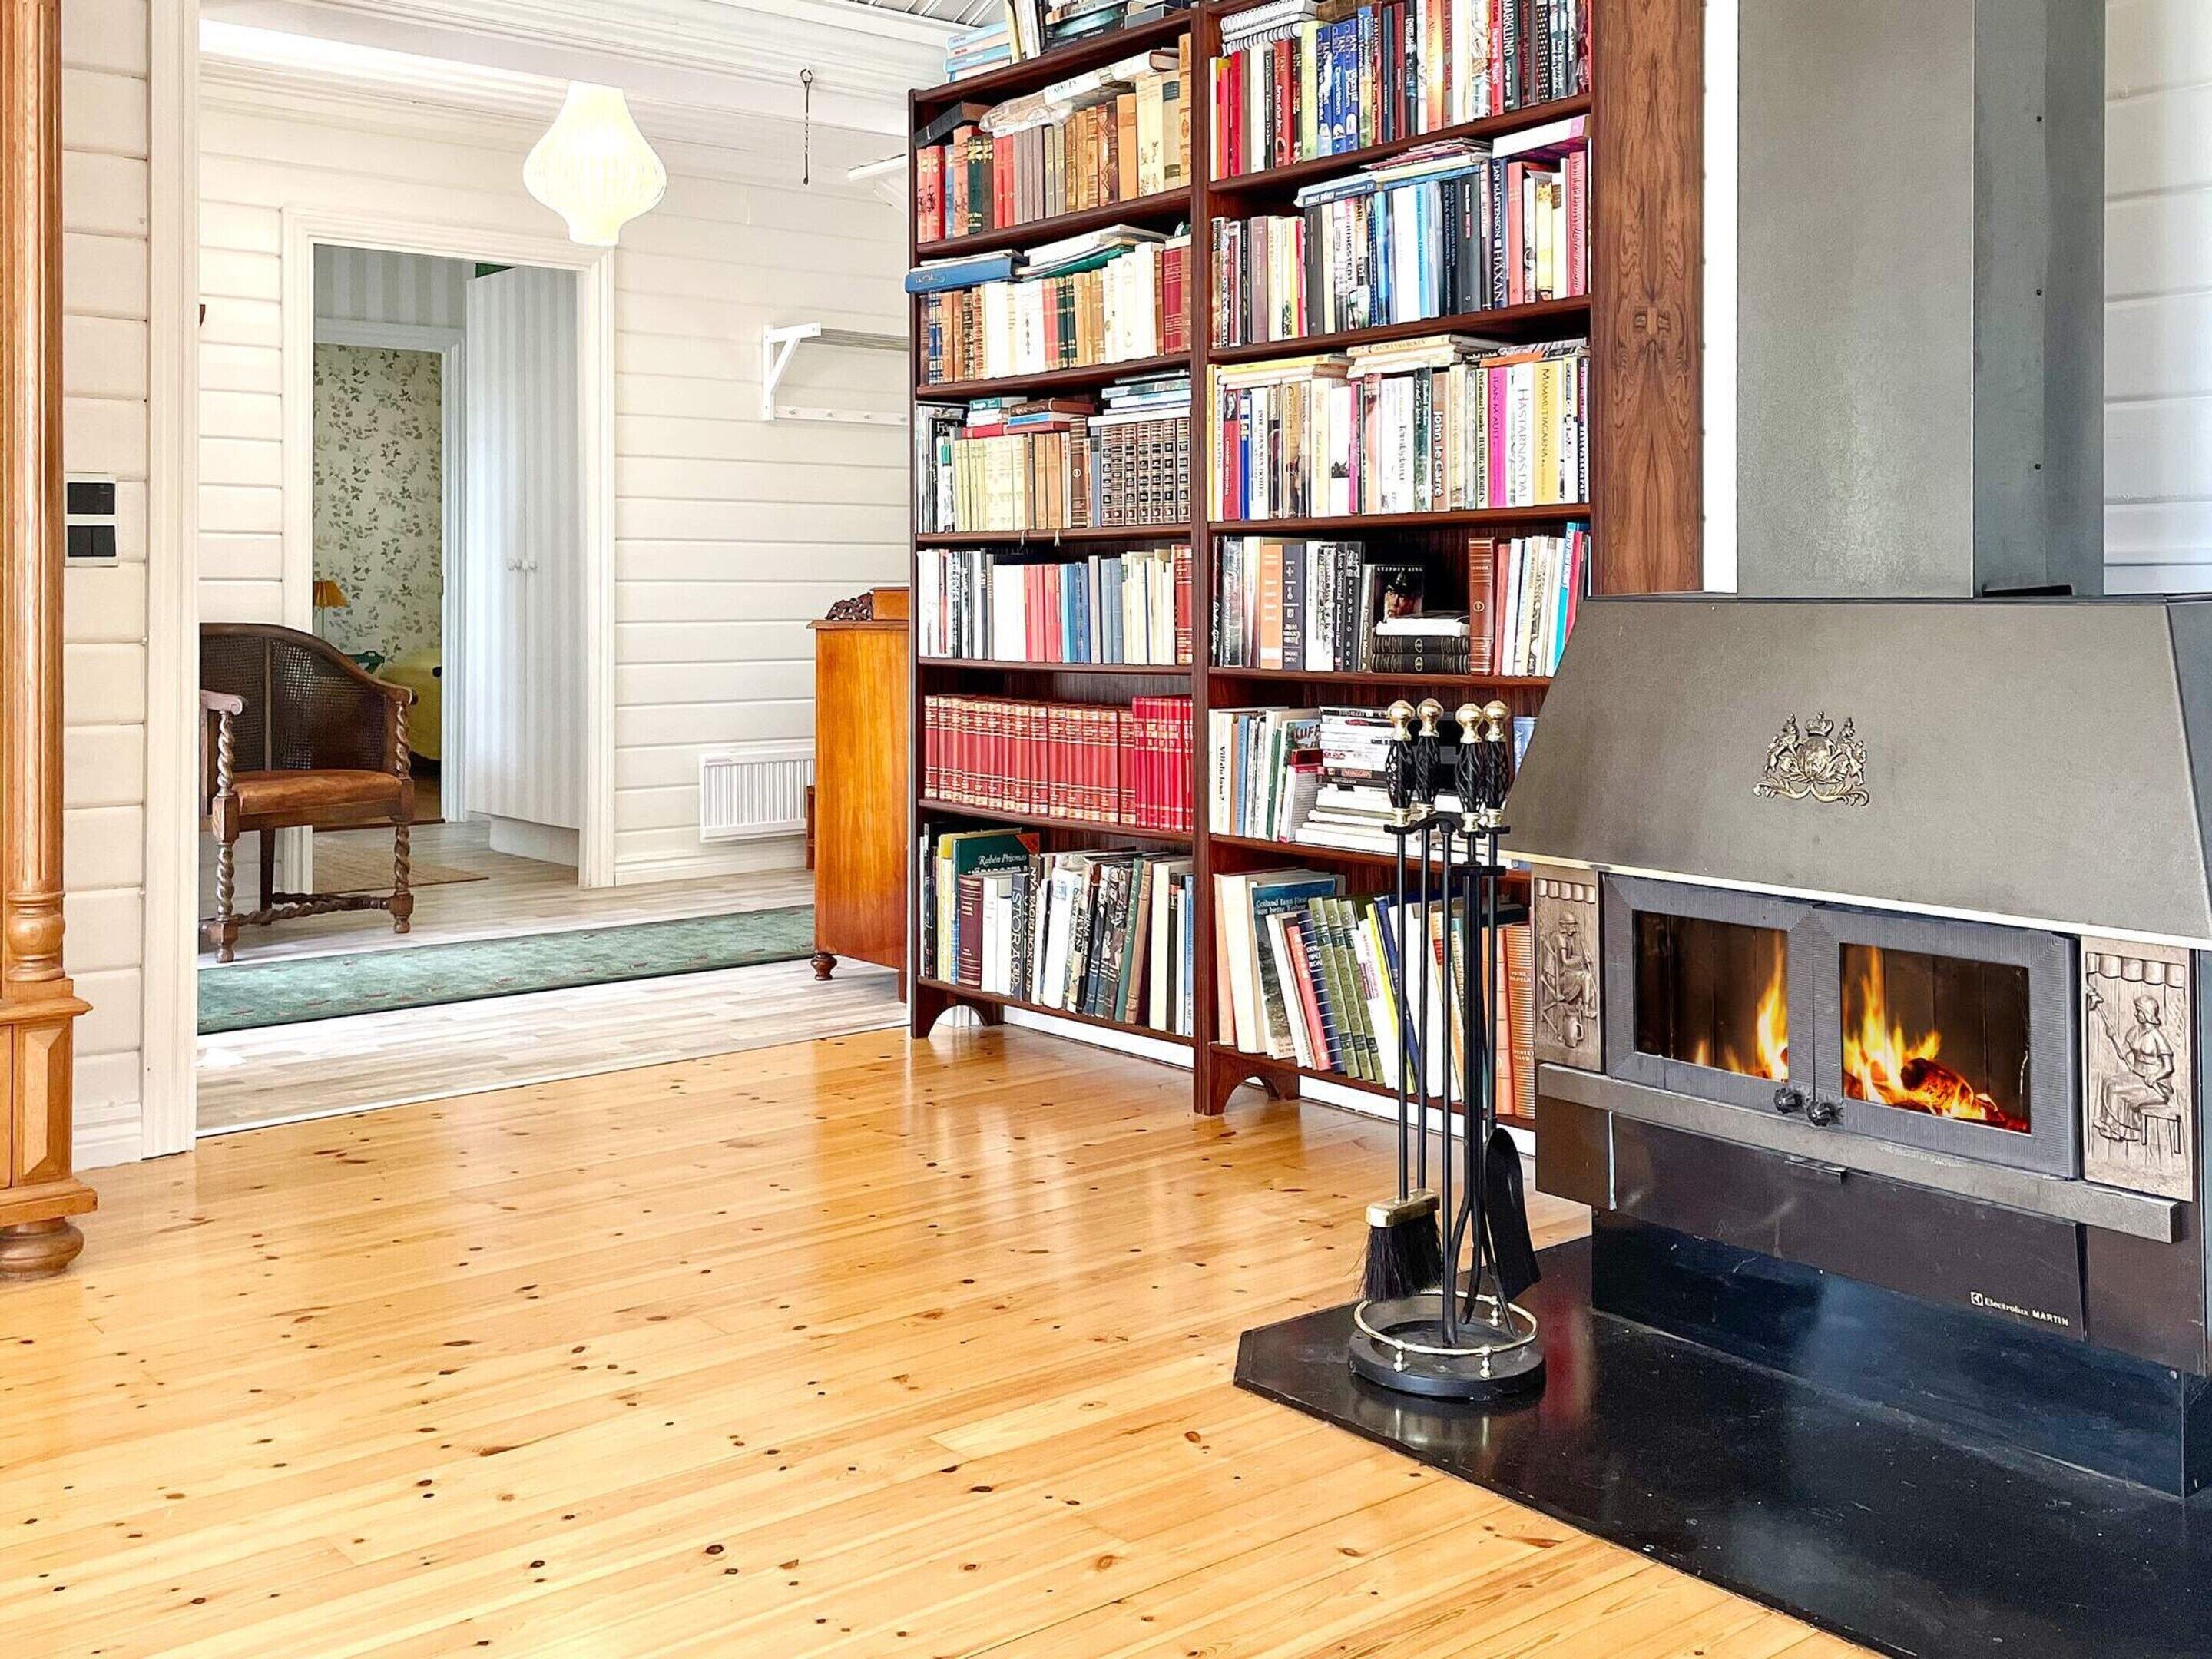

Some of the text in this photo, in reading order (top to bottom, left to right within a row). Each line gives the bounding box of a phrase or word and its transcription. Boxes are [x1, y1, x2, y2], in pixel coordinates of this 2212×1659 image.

[1503, 0, 1515, 57] MARKLUND
[1494, 184, 1502, 238] MÅRTENSON
[1494, 250, 1505, 301] HÄXAN
[1541, 369, 1550, 458] MAMMUTJAGARNA
[1434, 411, 1445, 497] John le Carré
[1518, 474, 1528, 498] DAL
[1337, 551, 1346, 568] Åsne
[1011, 892, 1022, 959] STORA
[1125, 869, 1138, 945] GREKLAND
[1256, 899, 1279, 908] Gotland
[1985, 1297, 2069, 1326] Electrolux MARTIN
